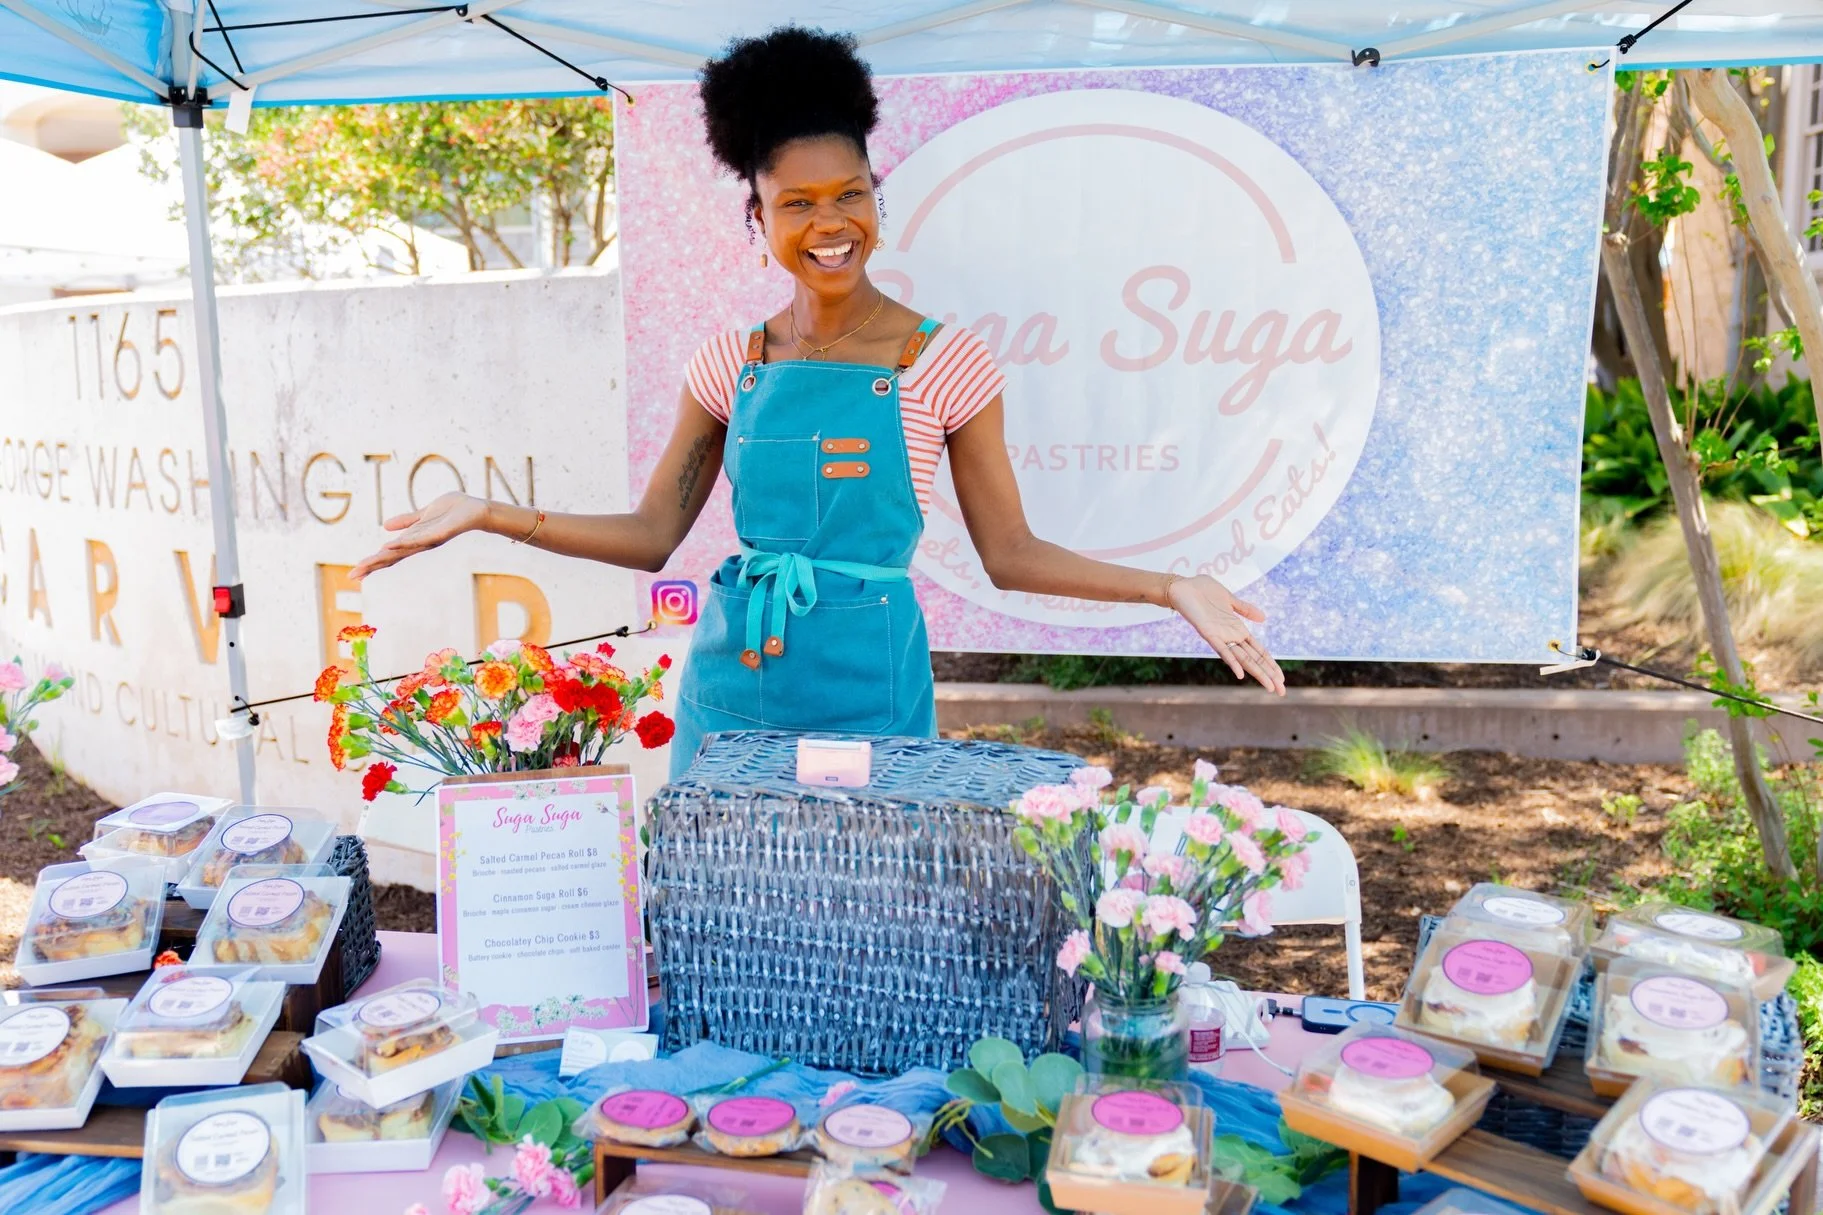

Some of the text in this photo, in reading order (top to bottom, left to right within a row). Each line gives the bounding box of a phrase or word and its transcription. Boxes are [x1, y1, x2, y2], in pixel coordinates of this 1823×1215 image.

[69, 308, 184, 400] 1165
[1099, 264, 1353, 416] Suga
[0, 436, 70, 502] ORGE
[1253, 421, 1337, 541] Eats!
[0, 526, 553, 686] ARVER
[115, 681, 310, 764] CULTUAL
[492, 803, 583, 833] Suga Suga
[480, 855, 506, 865] Salted
[540, 851, 566, 861] Pecan
[568, 849, 584, 859] Roll
[587, 847, 598, 857] $8
[493, 887, 588, 903] Cinnamon Suga Roll $6
[484, 930, 600, 949] Chocolatey Chip Cookie $3
